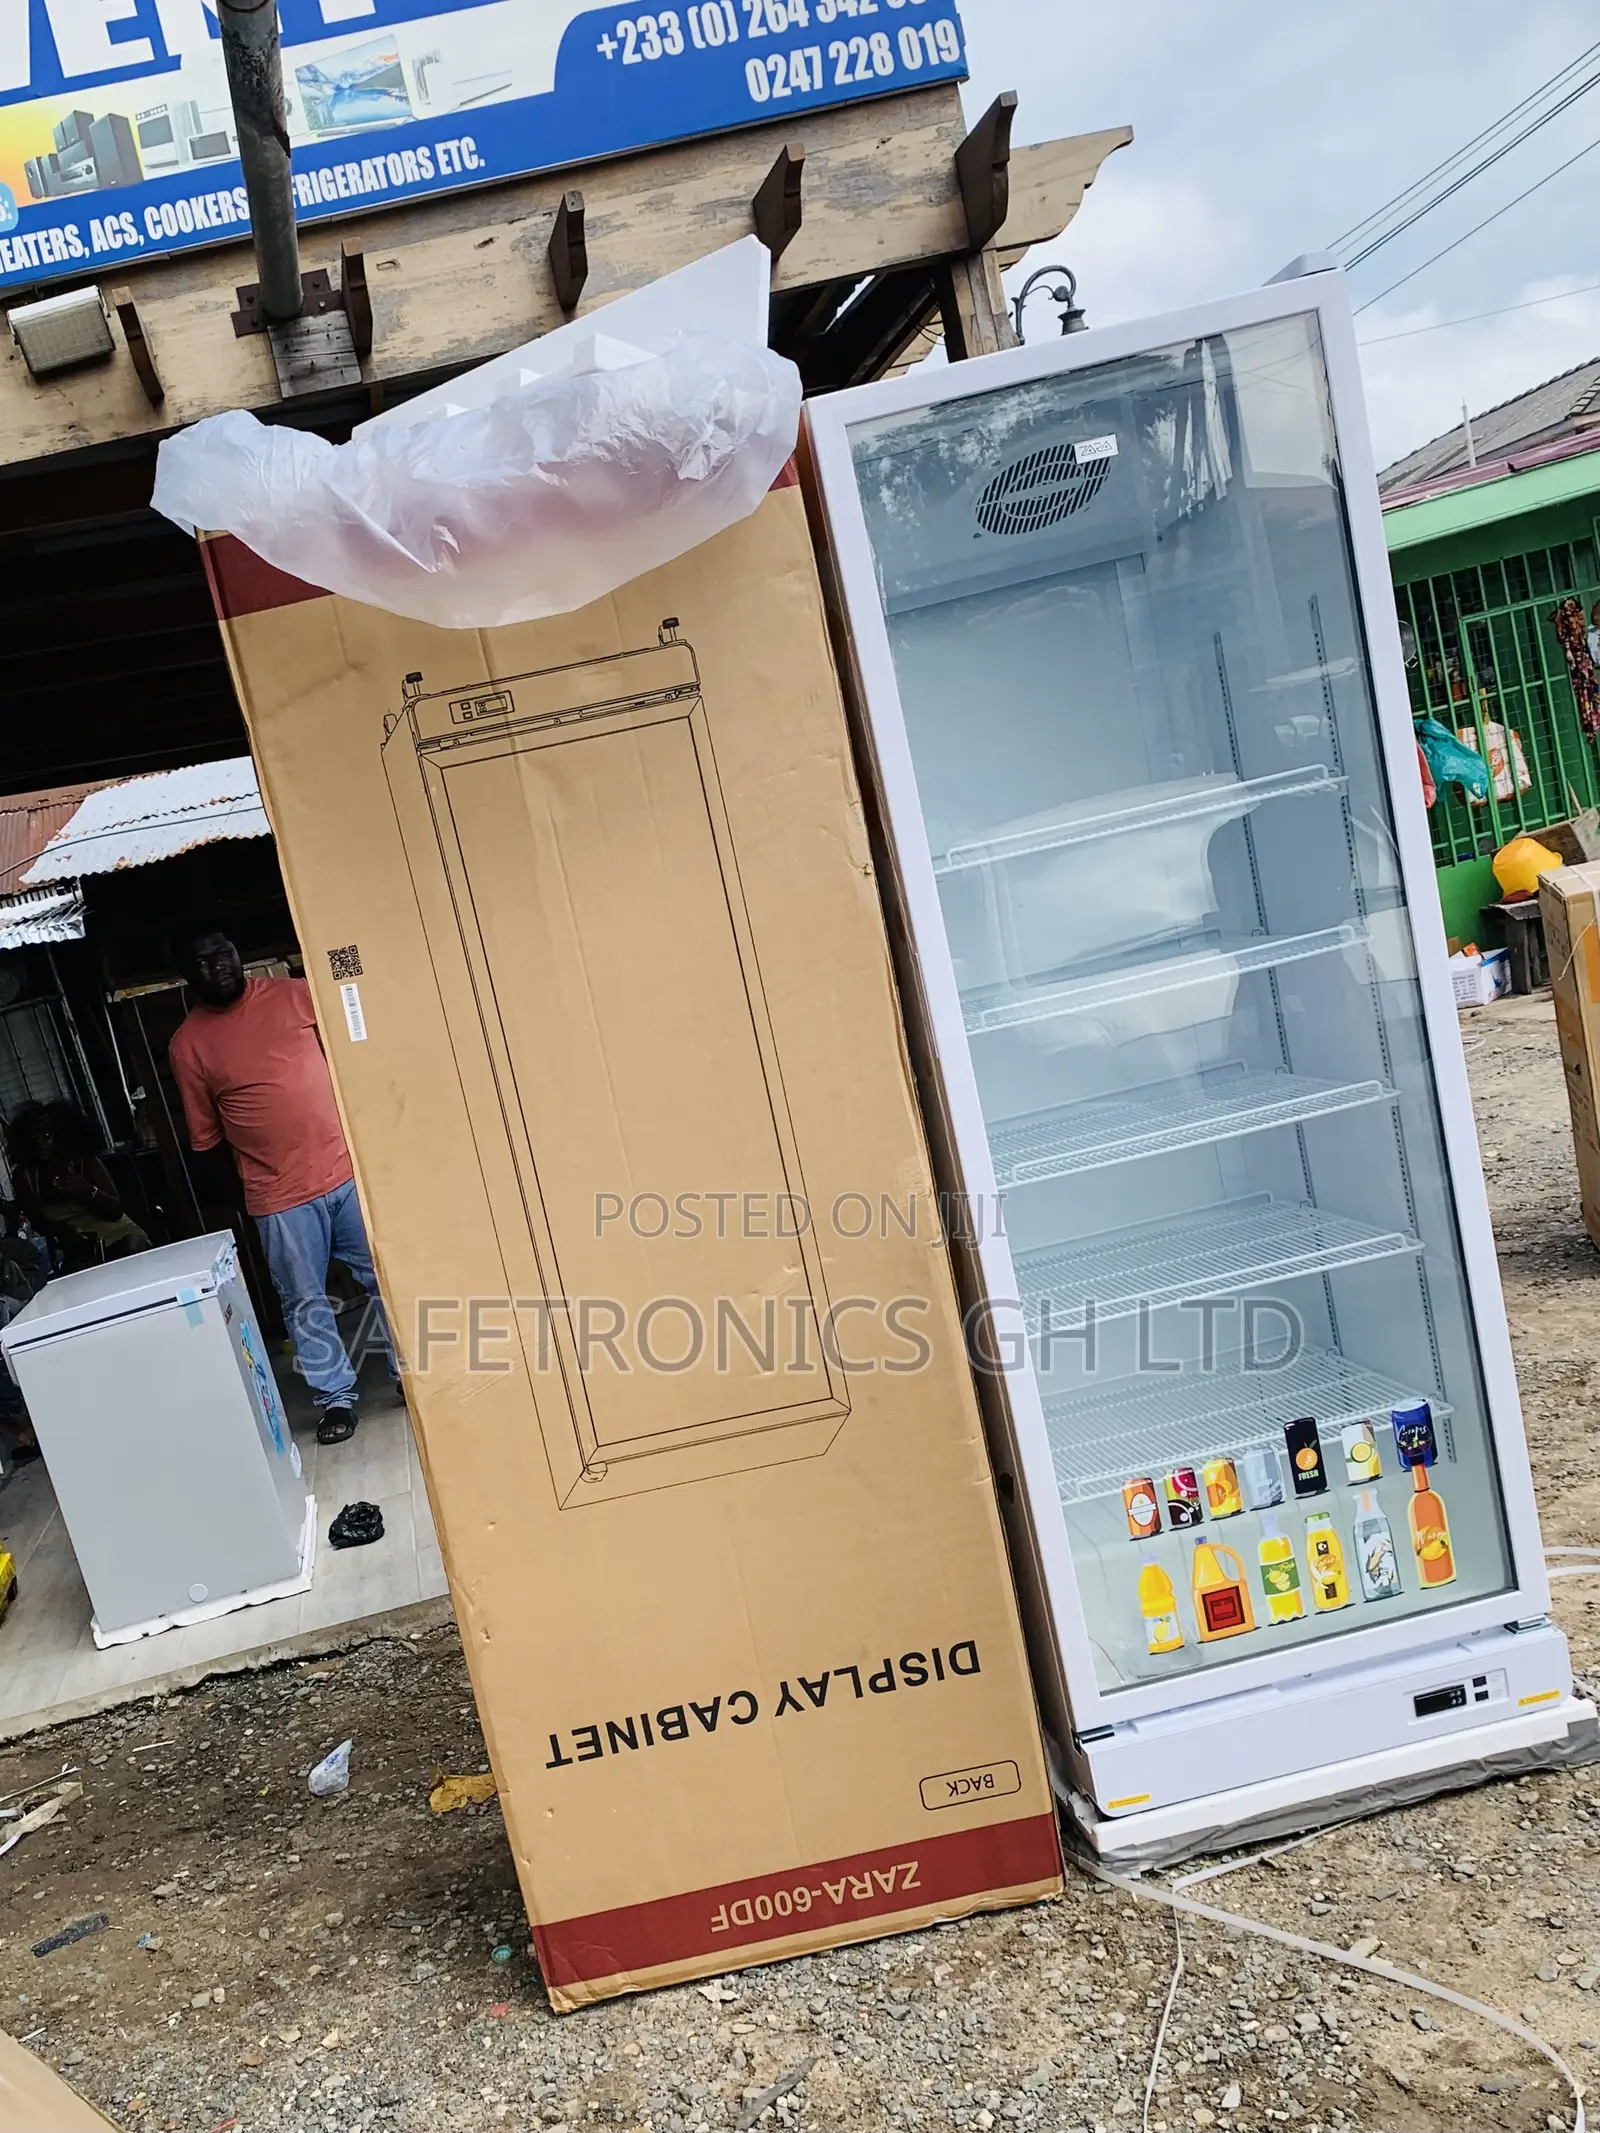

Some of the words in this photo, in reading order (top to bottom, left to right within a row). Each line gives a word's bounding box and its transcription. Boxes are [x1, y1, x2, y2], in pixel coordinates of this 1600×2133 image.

[596, 11, 685, 65] +233
[687, 0, 740, 49] (0)
[742, 0, 810, 38] 264
[745, 45, 824, 103] 0247
[828, 32, 895, 85] 228
[897, 19, 960, 70] 019
[0, 224, 90, 274] EATERS,
[90, 212, 145, 259] ACS,
[434, 136, 486, 176] ETC.
[1298, 1469, 1319, 1481] FRESH
[774, 1640, 982, 1717] DISPLAY
[545, 1690, 760, 1769] CABINET
[946, 1772, 996, 1797] BACK
[710, 1861, 921, 1933] ZARA-600DF
